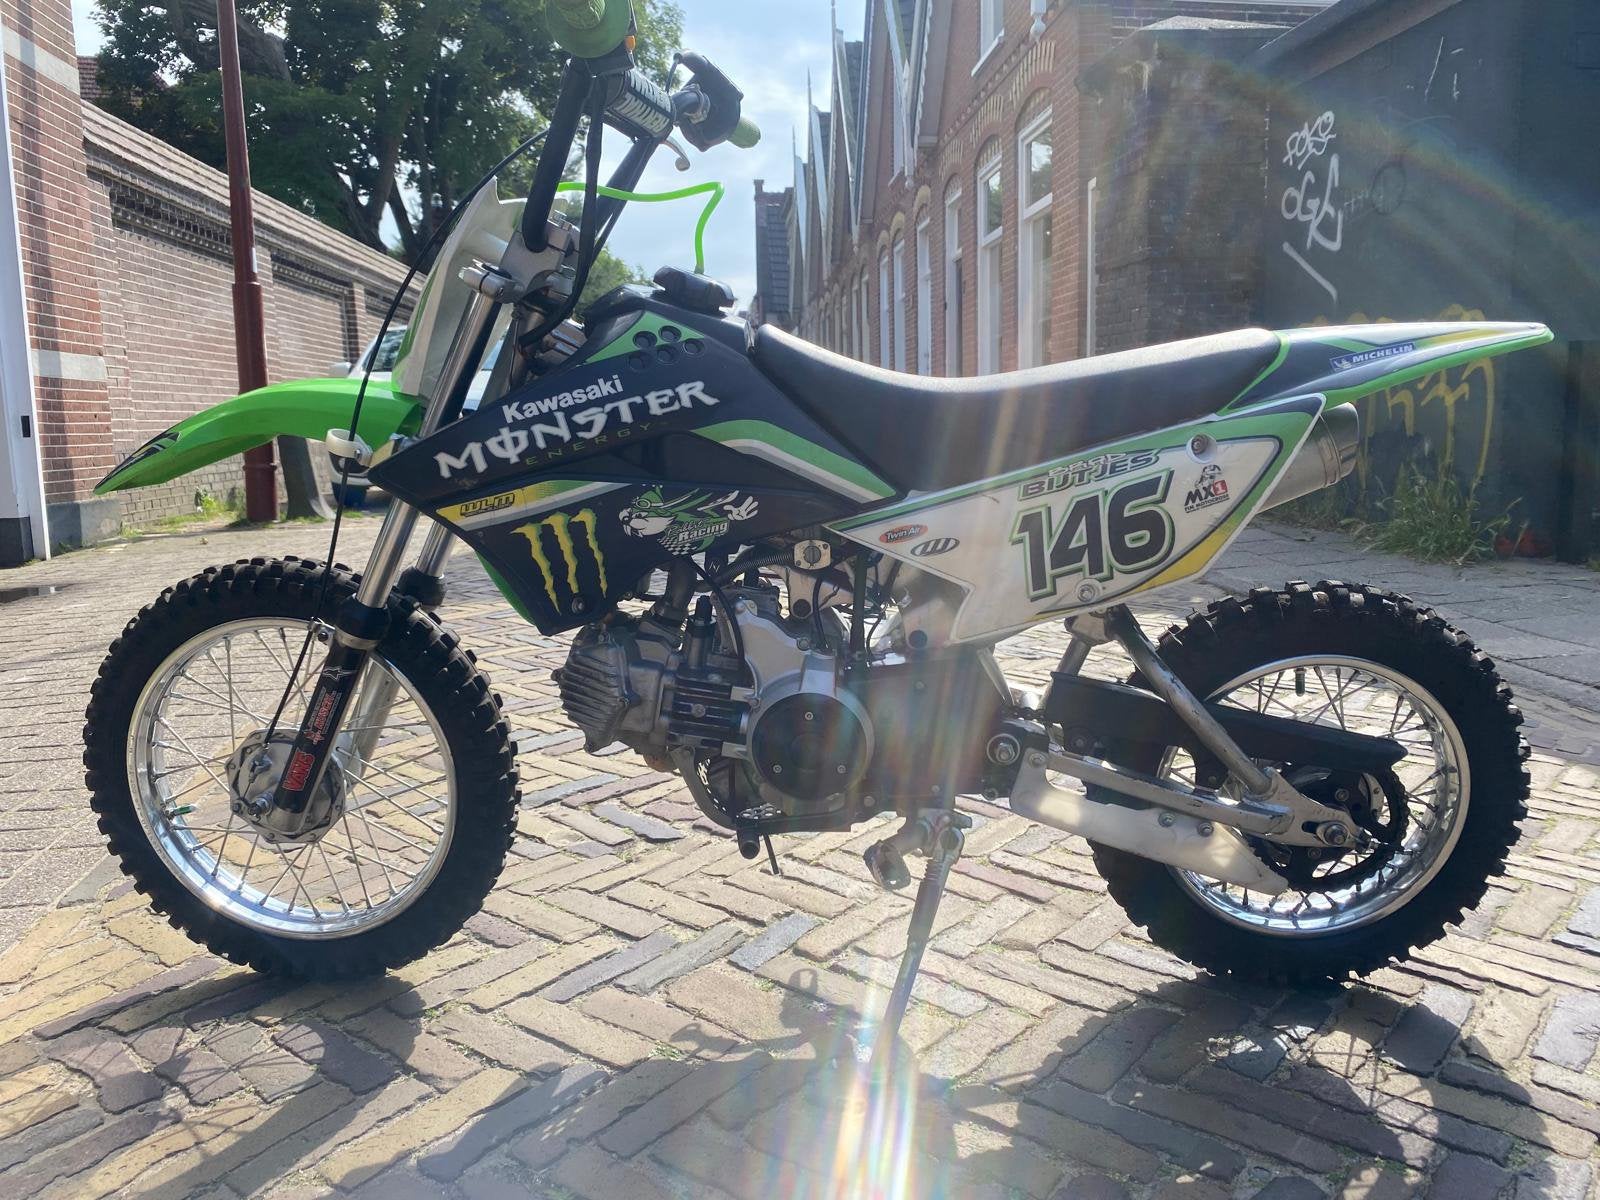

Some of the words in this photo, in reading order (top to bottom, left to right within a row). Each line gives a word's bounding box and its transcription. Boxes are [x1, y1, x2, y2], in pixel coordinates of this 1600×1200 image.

[1352, 343, 1413, 363] MICHELIN
[502, 374, 623, 423] Kawasaki
[433, 380, 720, 478] MONSTER
[526, 422, 651, 466] ENERGY
[1184, 479, 1228, 507] MX1
[678, 522, 728, 542] Racing
[1009, 468, 1175, 602] 146
